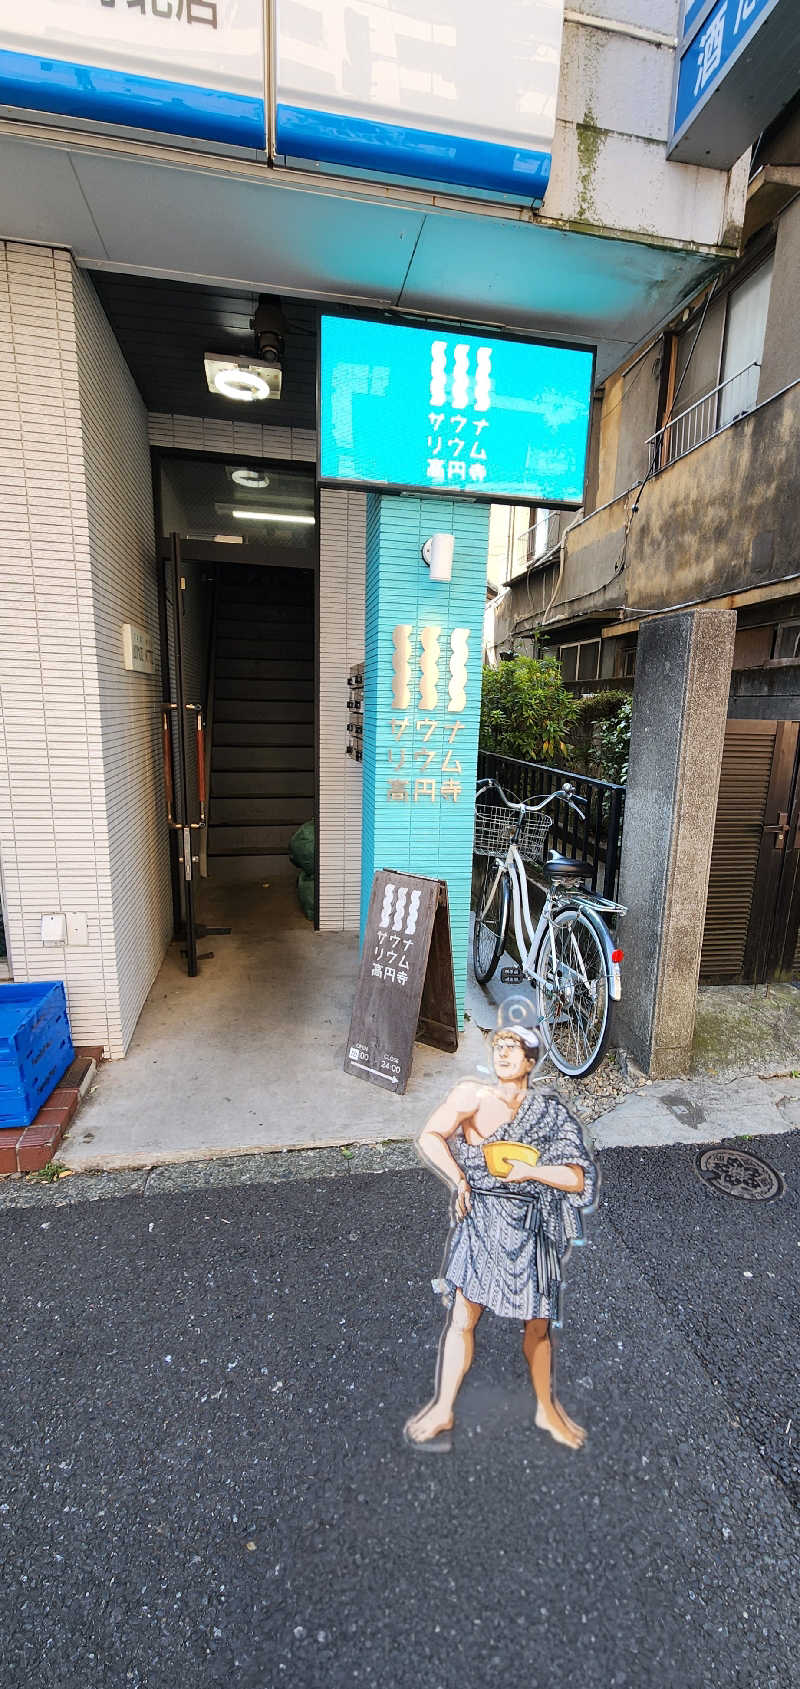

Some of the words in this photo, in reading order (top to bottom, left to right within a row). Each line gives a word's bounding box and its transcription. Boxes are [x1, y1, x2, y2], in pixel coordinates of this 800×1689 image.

[428, 412, 489, 436] サウナ
[427, 436, 487, 459] リウム
[426, 458, 488, 481] 高円寺
[389, 717, 465, 744] サウナ
[388, 748, 462, 773] リウム
[386, 777, 463, 803] 高円寺
[377, 930, 414, 951] サウナ
[374, 946, 409, 969] リウム
[371, 962, 409, 986] 高円寺
